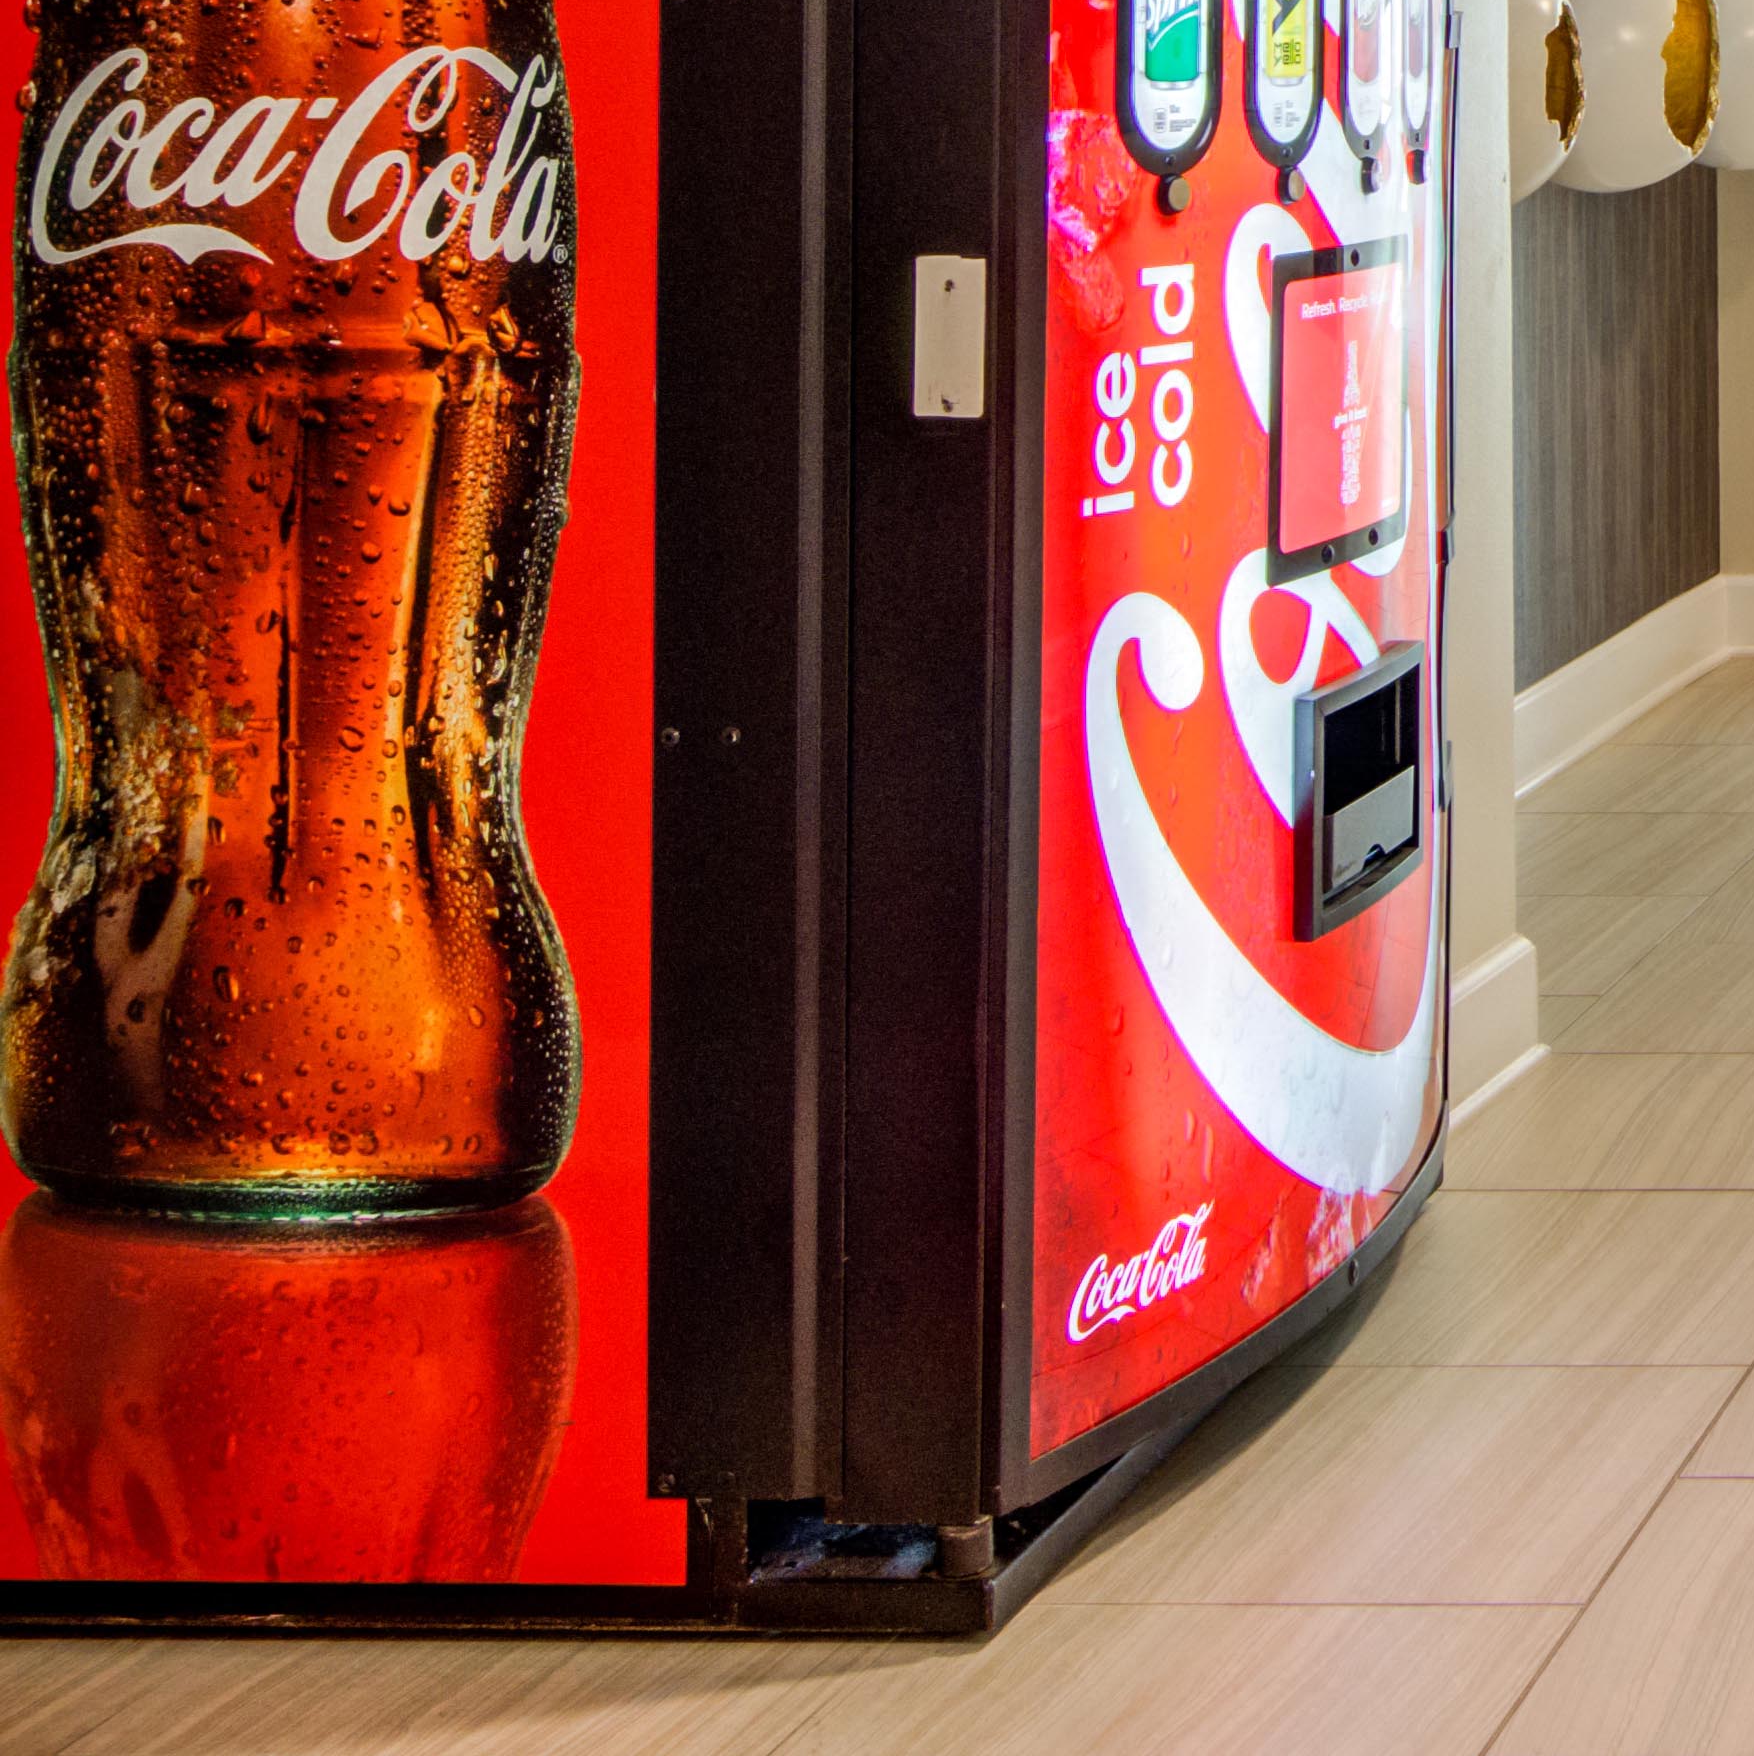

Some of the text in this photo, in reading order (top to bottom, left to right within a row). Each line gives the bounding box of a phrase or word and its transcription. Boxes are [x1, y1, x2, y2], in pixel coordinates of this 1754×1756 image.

[31, 45, 560, 265] Coca-Cola
[1081, 352, 1137, 518] ice
[1138, 263, 1195, 508] cold
[1066, 1197, 1215, 1343] Coca-Cola
